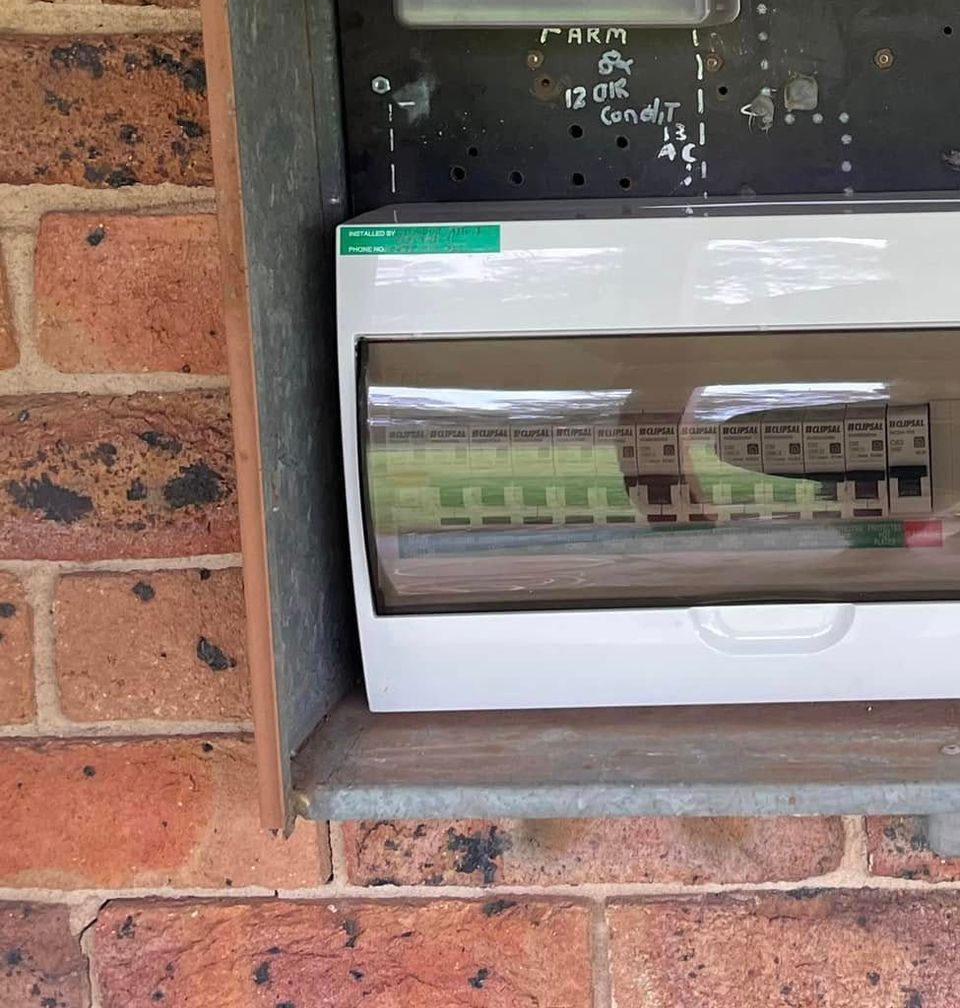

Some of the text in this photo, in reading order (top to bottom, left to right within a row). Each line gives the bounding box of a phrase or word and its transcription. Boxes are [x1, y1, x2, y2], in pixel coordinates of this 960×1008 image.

[855, 422, 883, 431] CLIPSAL
[896, 420, 924, 428] CLIPSAL
[646, 426, 675, 435] CLIPSAL
[729, 425, 758, 435] CLIPSAL
[771, 425, 800, 434] CLIPSAL
[813, 424, 841, 434] CLIPSAL
